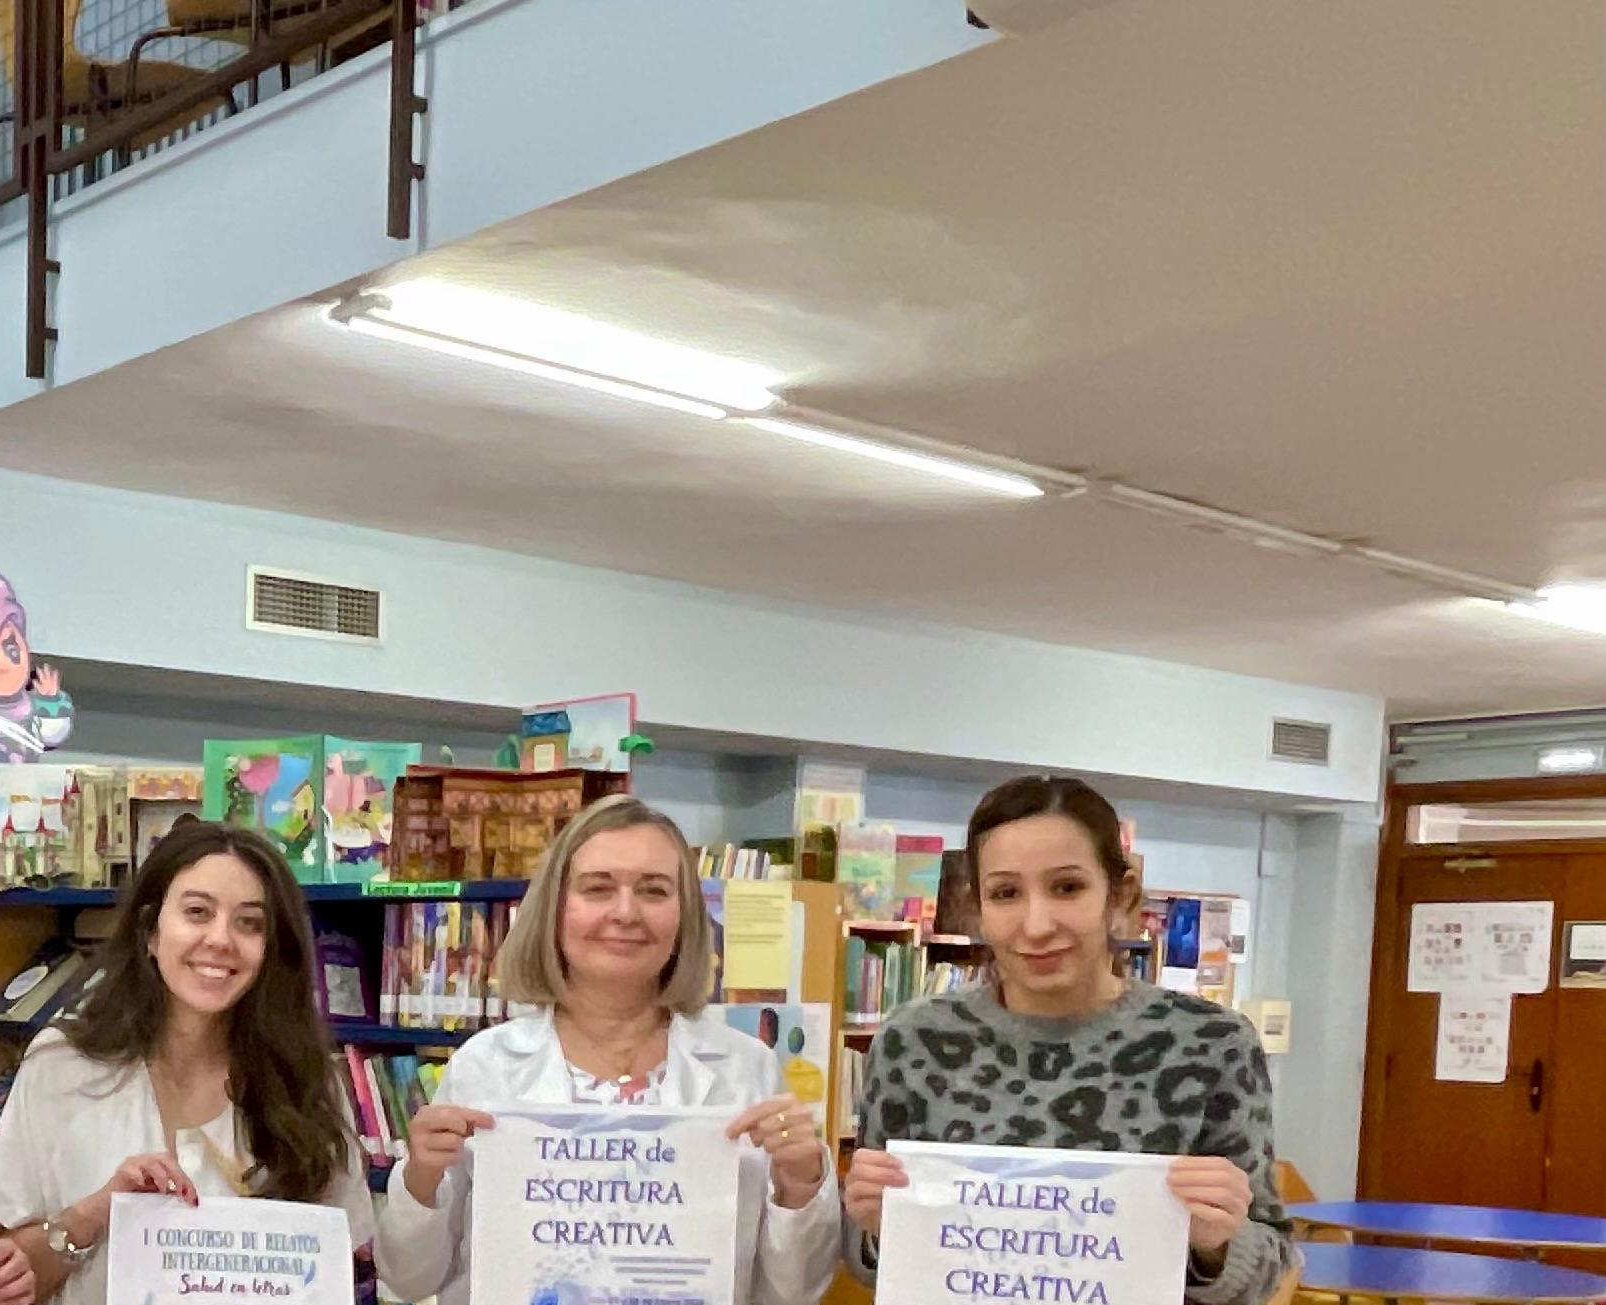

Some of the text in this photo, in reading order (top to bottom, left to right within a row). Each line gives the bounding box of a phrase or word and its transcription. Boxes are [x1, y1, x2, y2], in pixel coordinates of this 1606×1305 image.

[535, 1136, 677, 1163] TALLER de
[525, 1178, 683, 1204] ESCRITURA
[954, 1180, 1116, 1216] TALLER de
[157, 1228, 234, 1247] CONCURSO
[241, 1231, 258, 1249] DE
[266, 1233, 321, 1253] RELATOS
[532, 1220, 675, 1247] CREATIVA
[940, 1224, 1124, 1261] ESCRITURA
[162, 1252, 304, 1275] INTERGENERACIONAL
[178, 1273, 291, 1296] Salud en letras
[946, 1268, 1109, 1305] CREATIVA
